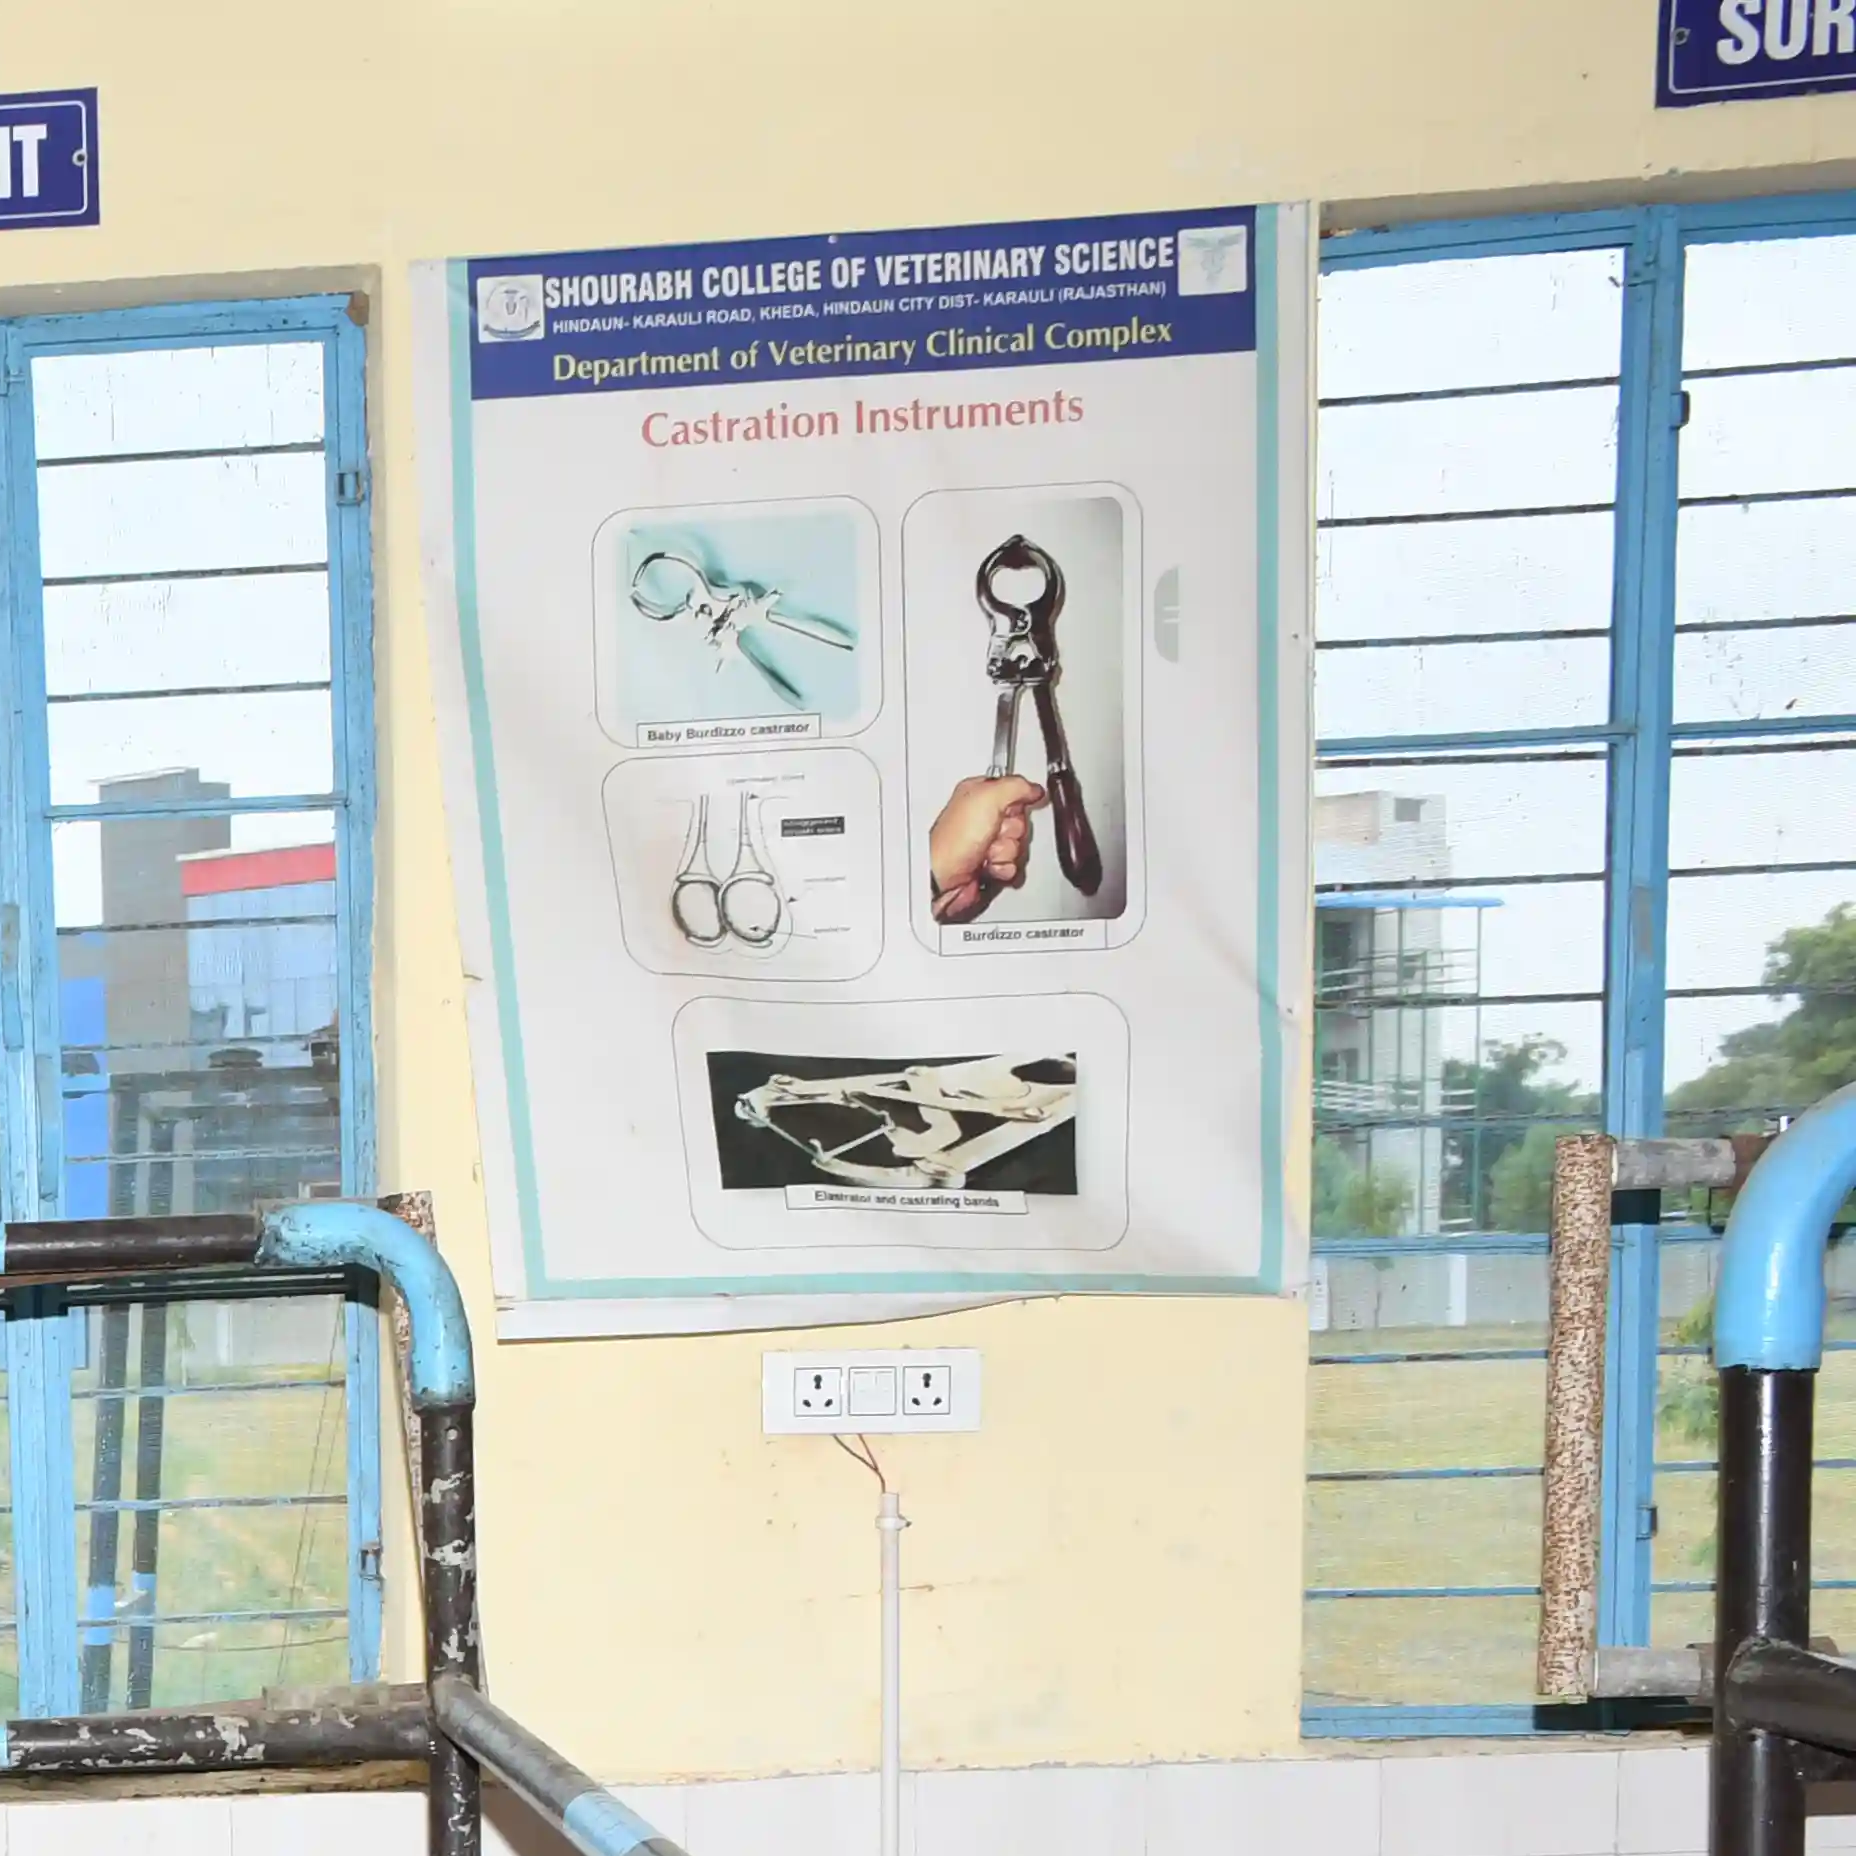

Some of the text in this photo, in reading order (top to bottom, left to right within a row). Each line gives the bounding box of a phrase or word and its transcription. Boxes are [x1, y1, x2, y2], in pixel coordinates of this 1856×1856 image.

[545, 236, 1174, 308] SHOURABH COLLEGE OF VETERINARY SCIENCE
[633, 312, 702, 329] KARAULI
[707, 308, 755, 325] ROAD,
[760, 304, 819, 322] KHEDA,
[823, 299, 895, 316] HINDAUN
[898, 297, 933, 312] CITY
[983, 289, 1053, 307] KARAULI
[1058, 282, 1166, 304] (RAJASTHAN)
[553, 316, 1172, 385] Department of Veterinary Clinical Complex
[642, 389, 1084, 447] Castration Instruments
[647, 723, 810, 742] Baby Burdizzo castrator
[963, 927, 1085, 942] Burdizzo castrator
